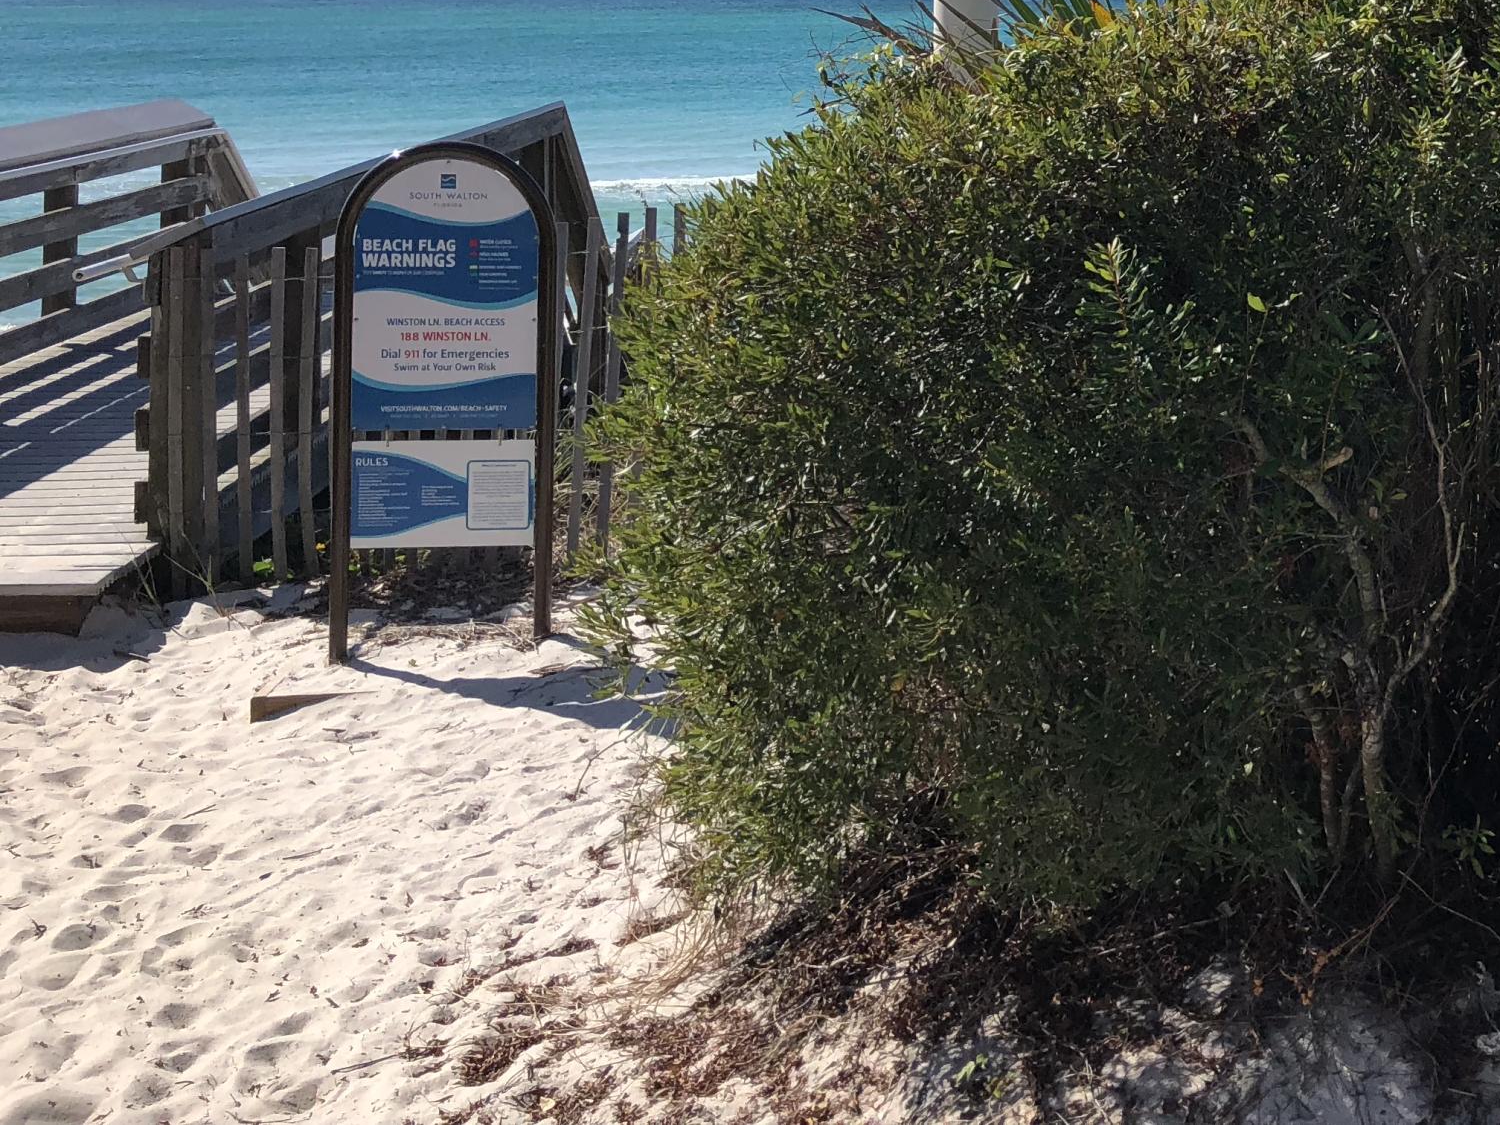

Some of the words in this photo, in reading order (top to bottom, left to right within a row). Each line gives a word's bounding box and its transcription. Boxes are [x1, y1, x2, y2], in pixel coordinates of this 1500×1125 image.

[409, 192, 441, 200] SOUTH
[447, 192, 488, 200] WALTON
[363, 239, 412, 251] BEACH
[419, 239, 456, 252] FLAG
[363, 254, 456, 268] WARNINGS
[387, 318, 425, 326] WINSTON
[428, 318, 441, 326] LN.
[444, 318, 472, 326] BEACH
[474, 318, 505, 326] ACCESS
[401, 332, 419, 341] 188
[423, 332, 471, 341] WINSTON
[474, 332, 491, 341] LN.
[381, 349, 401, 358] Dial
[404, 349, 420, 358] 911
[423, 349, 438, 358] for
[441, 349, 509, 361] Emergencies
[394, 363, 418, 371] Swim
[422, 363, 430, 371] at
[433, 363, 452, 371] Your
[455, 363, 475, 371] Own
[478, 363, 496, 371] Risk
[356, 458, 388, 466] RULES
